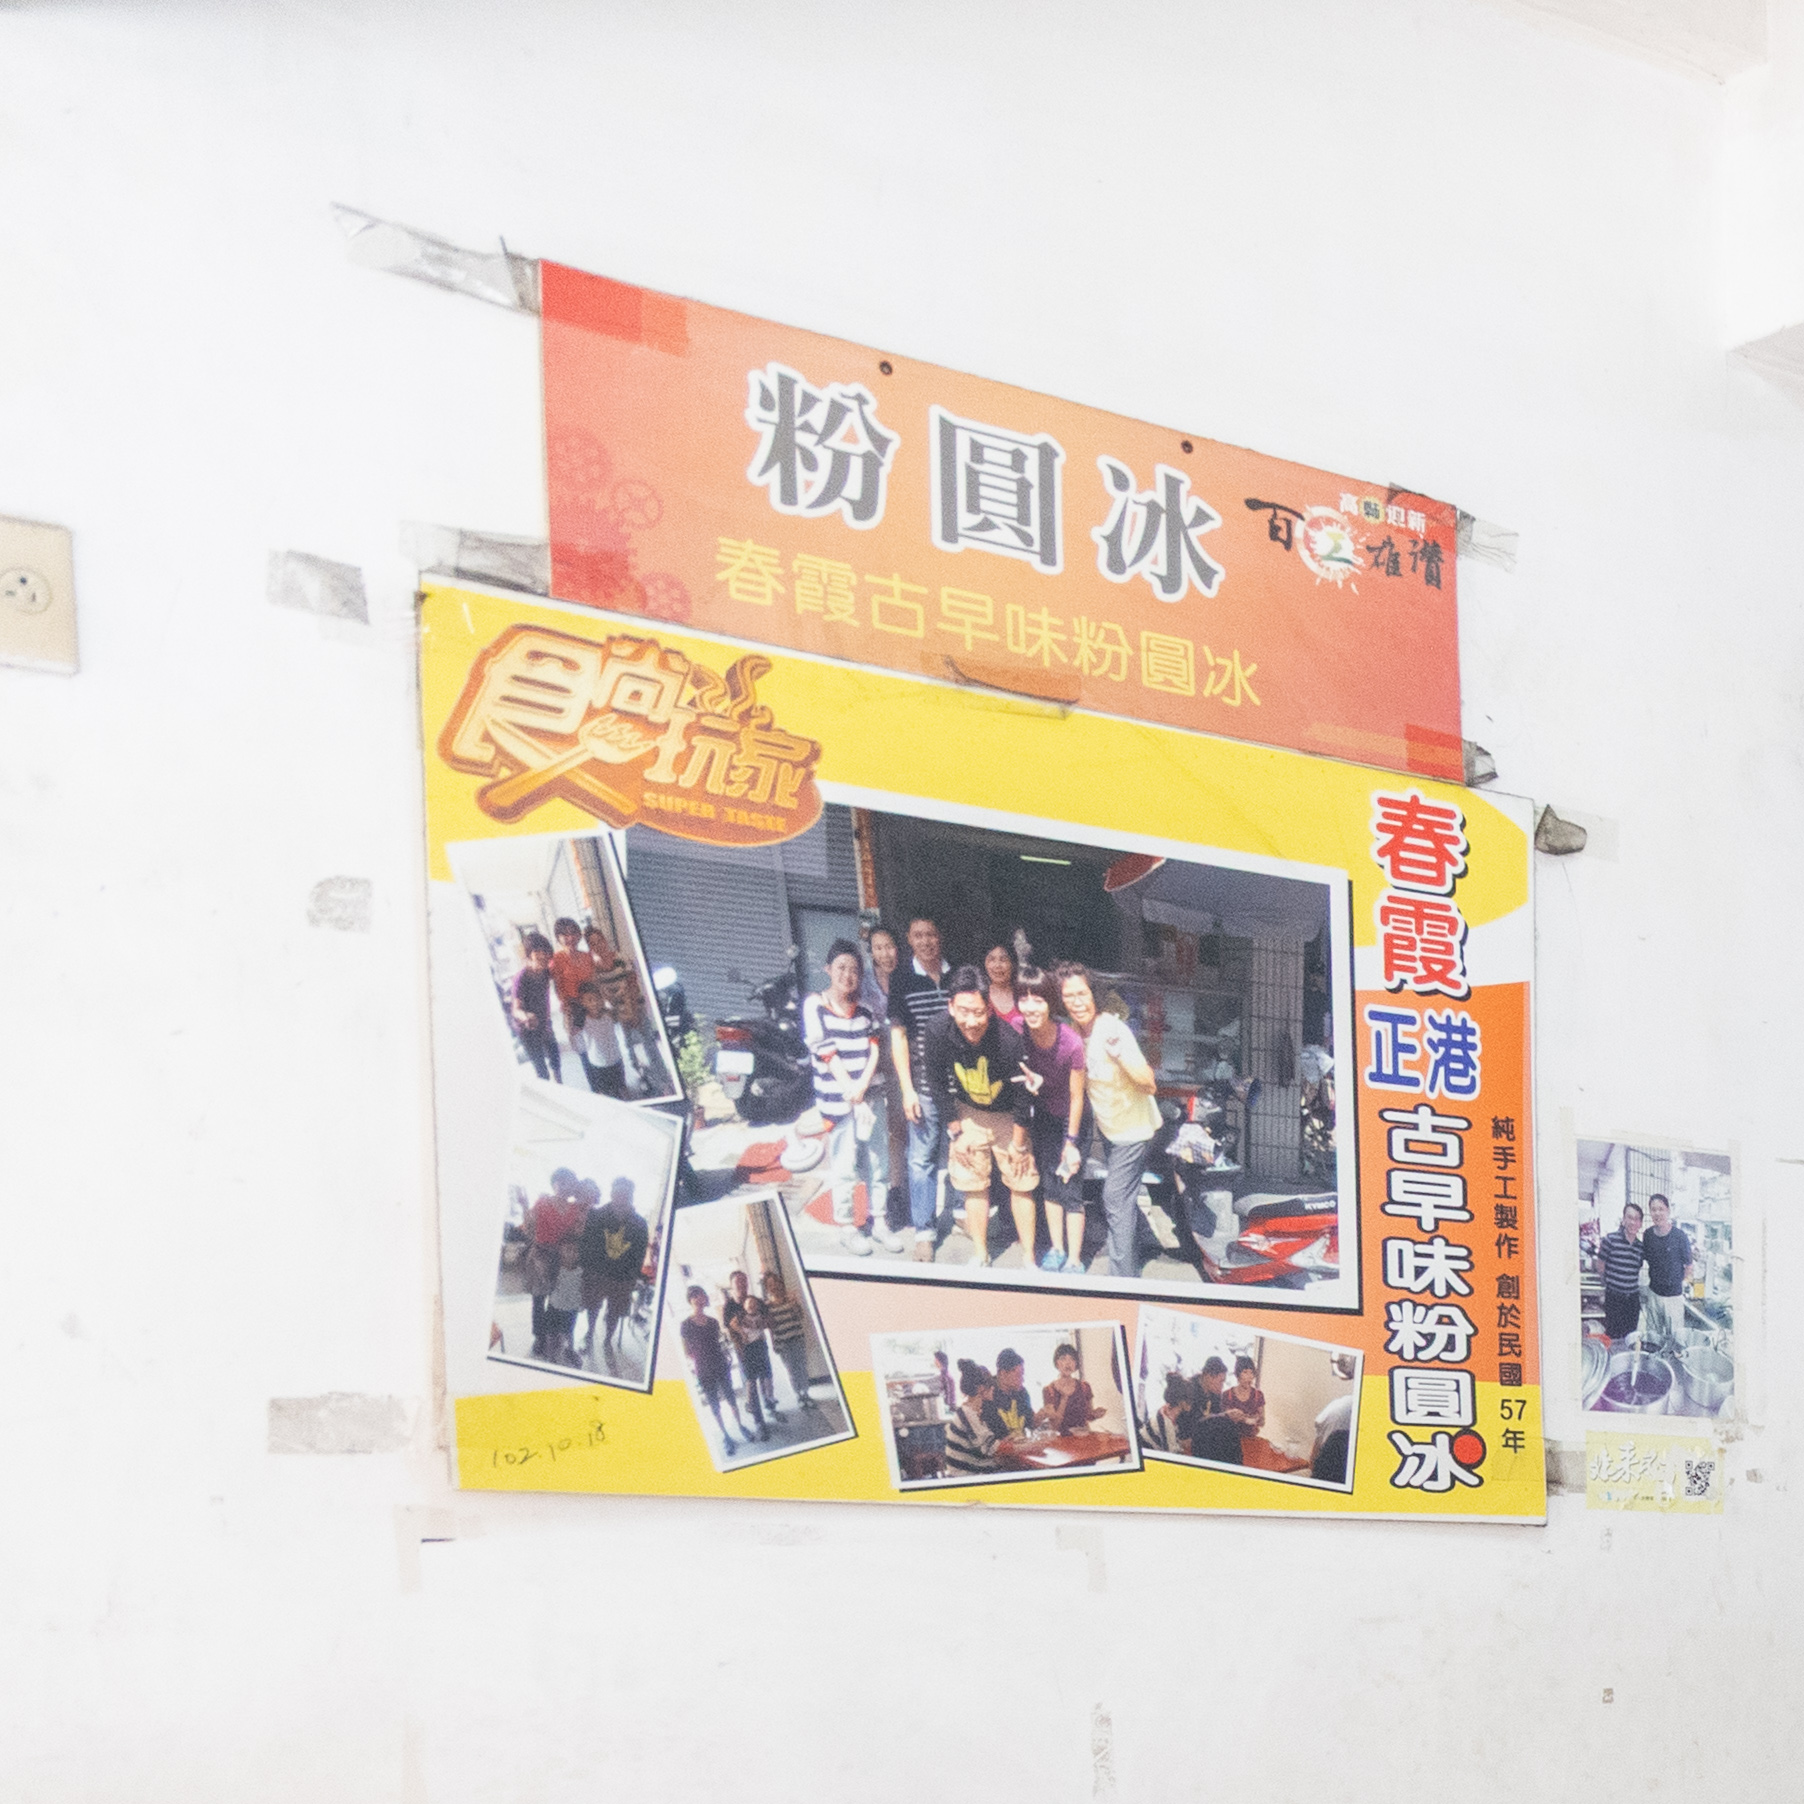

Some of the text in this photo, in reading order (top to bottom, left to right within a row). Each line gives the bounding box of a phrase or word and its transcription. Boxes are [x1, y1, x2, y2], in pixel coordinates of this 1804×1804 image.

[750, 366, 1221, 596] 粉圓冰
[716, 534, 1261, 707] 春霞古早味粉圓冰
[643, 791, 787, 833] SUPER TASTE
[1374, 794, 1463, 991] 春霞
[1367, 1008, 1479, 1095] 正港
[1304, 1200, 1337, 1211] KYMCO
[1491, 1116, 1521, 1260] 純手工製作
[1380, 1103, 1485, 1492] 古早味粉圓冰
